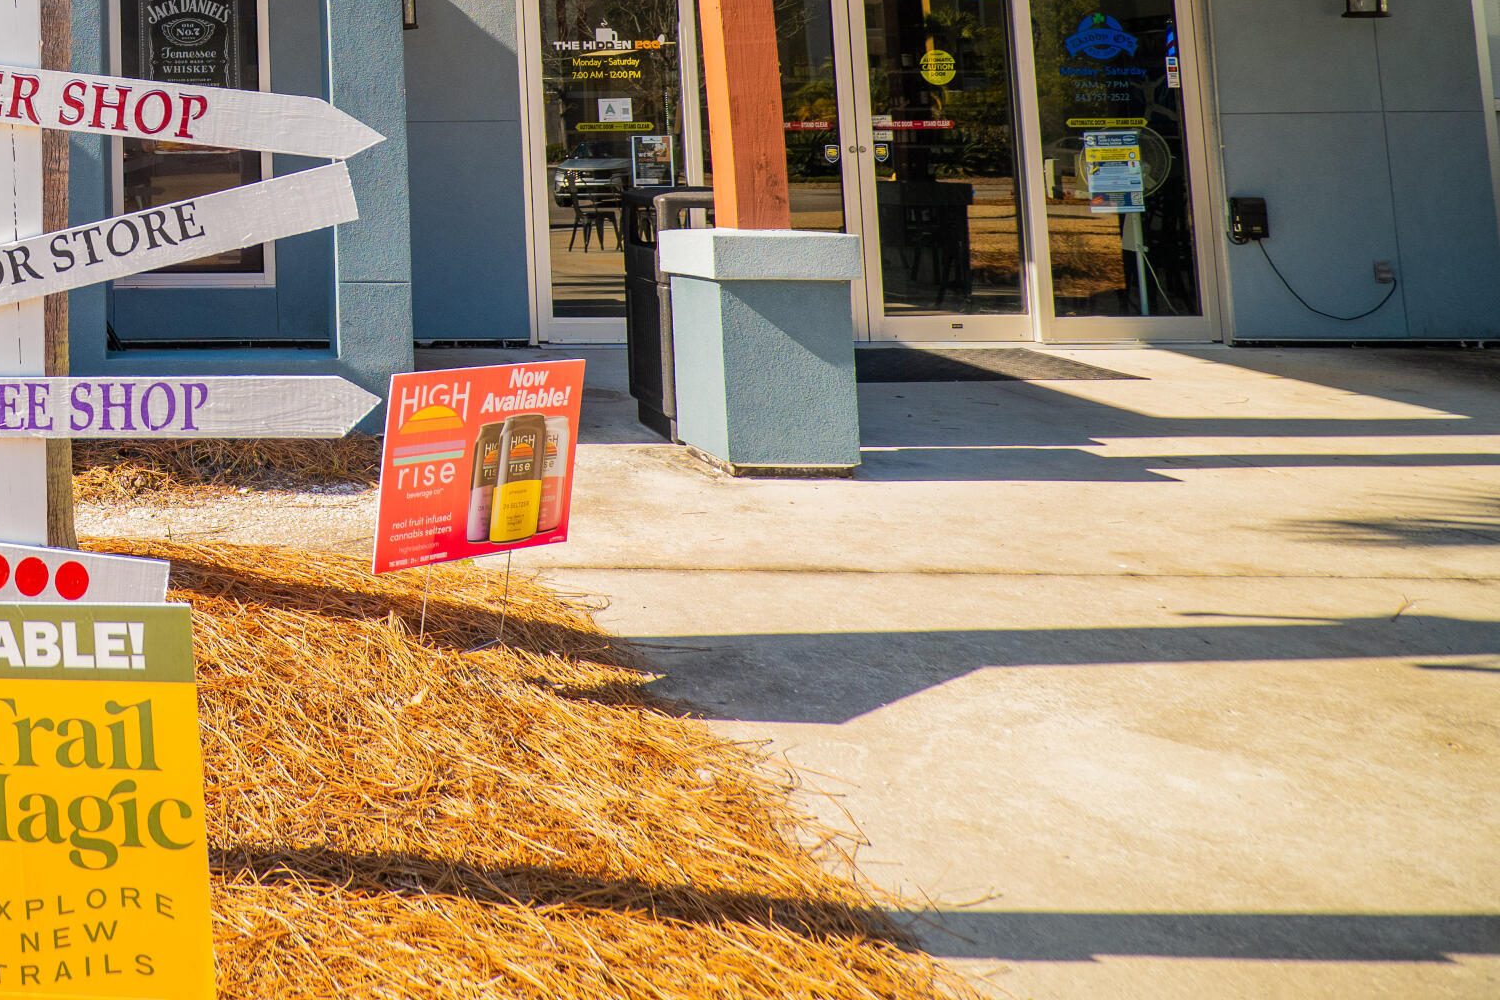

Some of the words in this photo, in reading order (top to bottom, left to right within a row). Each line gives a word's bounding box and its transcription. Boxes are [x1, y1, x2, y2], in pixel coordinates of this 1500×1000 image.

[161, 46, 217, 59] Tennessee
[553, 40, 580, 51] THE
[583, 40, 632, 51] HIDDEN
[634, 40, 662, 51] EGG
[162, 64, 217, 74] WHISKEY
[572, 58, 603, 68] Monday
[608, 57, 640, 68] Saturday
[921, 63, 954, 71] CAUTION
[572, 71, 589, 79] 7:00
[589, 71, 604, 79] AM
[609, 71, 628, 79] 12:00
[628, 71, 641, 79] PM
[57, 79, 209, 140] SHOP
[605, 103, 616, 114] A
[50, 200, 206, 274] STORE
[509, 367, 549, 389] Now
[68, 381, 209, 432] SHOP
[398, 381, 471, 430] HIGH
[480, 386, 572, 414] Available!
[510, 434, 536, 450] HIGH
[509, 462, 531, 473] rise
[397, 461, 457, 491] rise
[406, 489, 433, 499] beverage
[392, 519, 407, 530] real
[408, 516, 424, 527] fruit
[425, 511, 452, 525] infused
[389, 528, 424, 542] cannabis
[424, 525, 452, 537] seltzers
[20, 920, 119, 954] NEW
